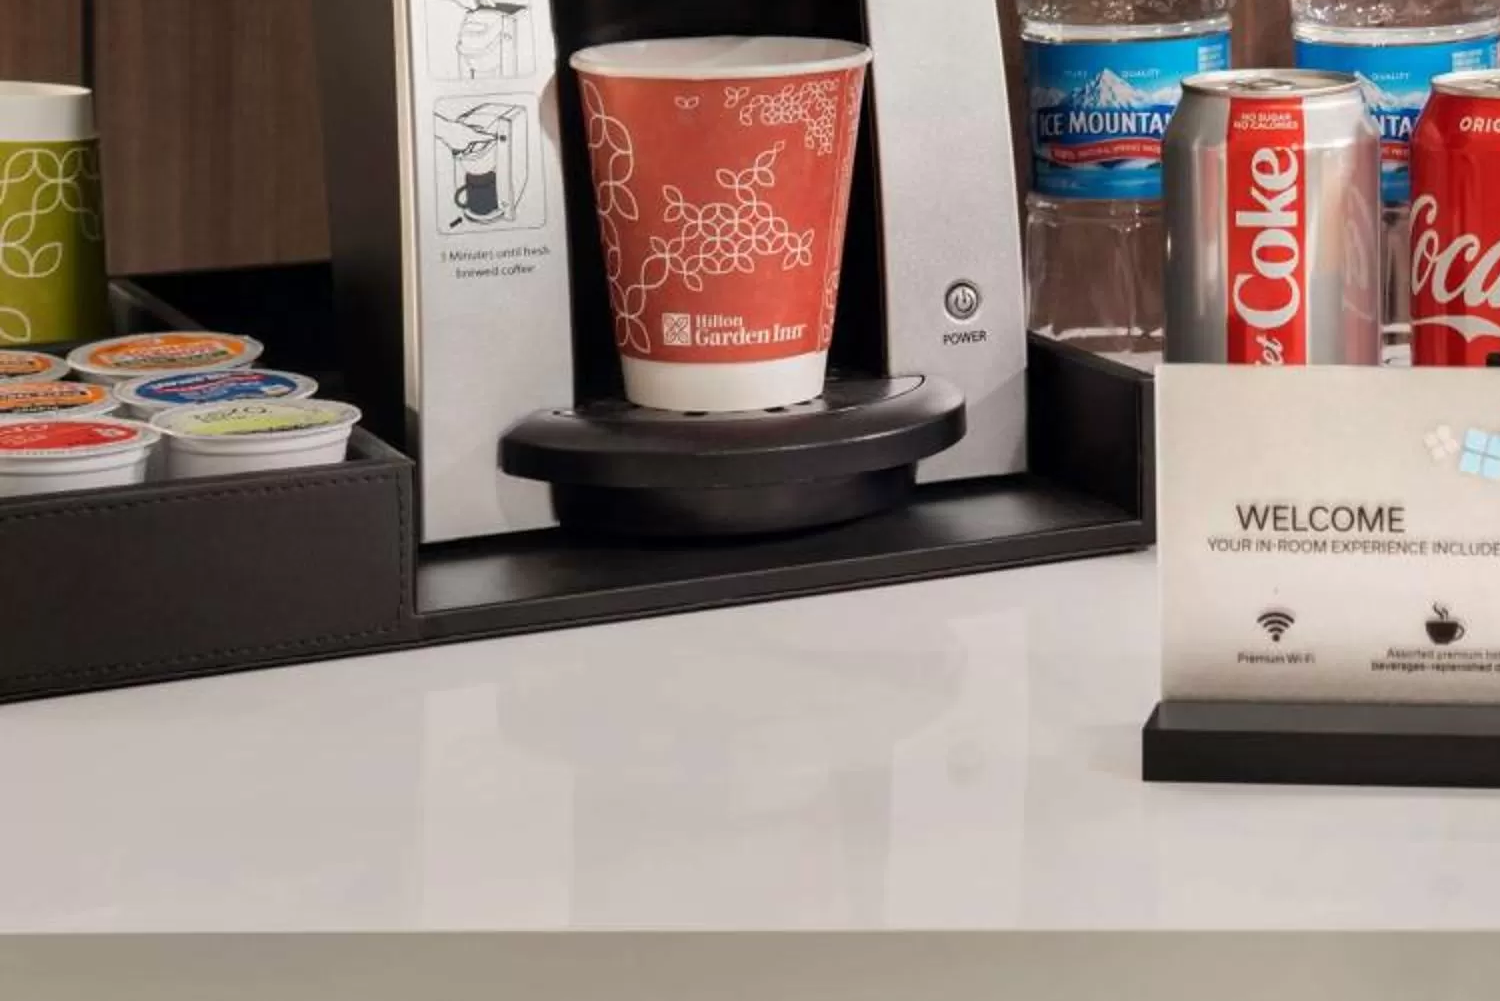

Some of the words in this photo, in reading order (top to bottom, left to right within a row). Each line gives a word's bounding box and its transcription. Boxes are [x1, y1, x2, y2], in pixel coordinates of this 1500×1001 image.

[1039, 113, 1064, 136] ICE
[1232, 147, 1301, 330] Coke
[694, 313, 745, 329] Hilton
[694, 326, 770, 348] Garden
[772, 322, 809, 343] Inn
[942, 330, 988, 346] POWER
[1235, 503, 1406, 533] WELCOME
[1207, 537, 1251, 553] YOUR
[1255, 538, 1328, 554] IN-ROOM
[1331, 539, 1428, 556] EXPERIENCE
[1236, 651, 1285, 664] Premium
